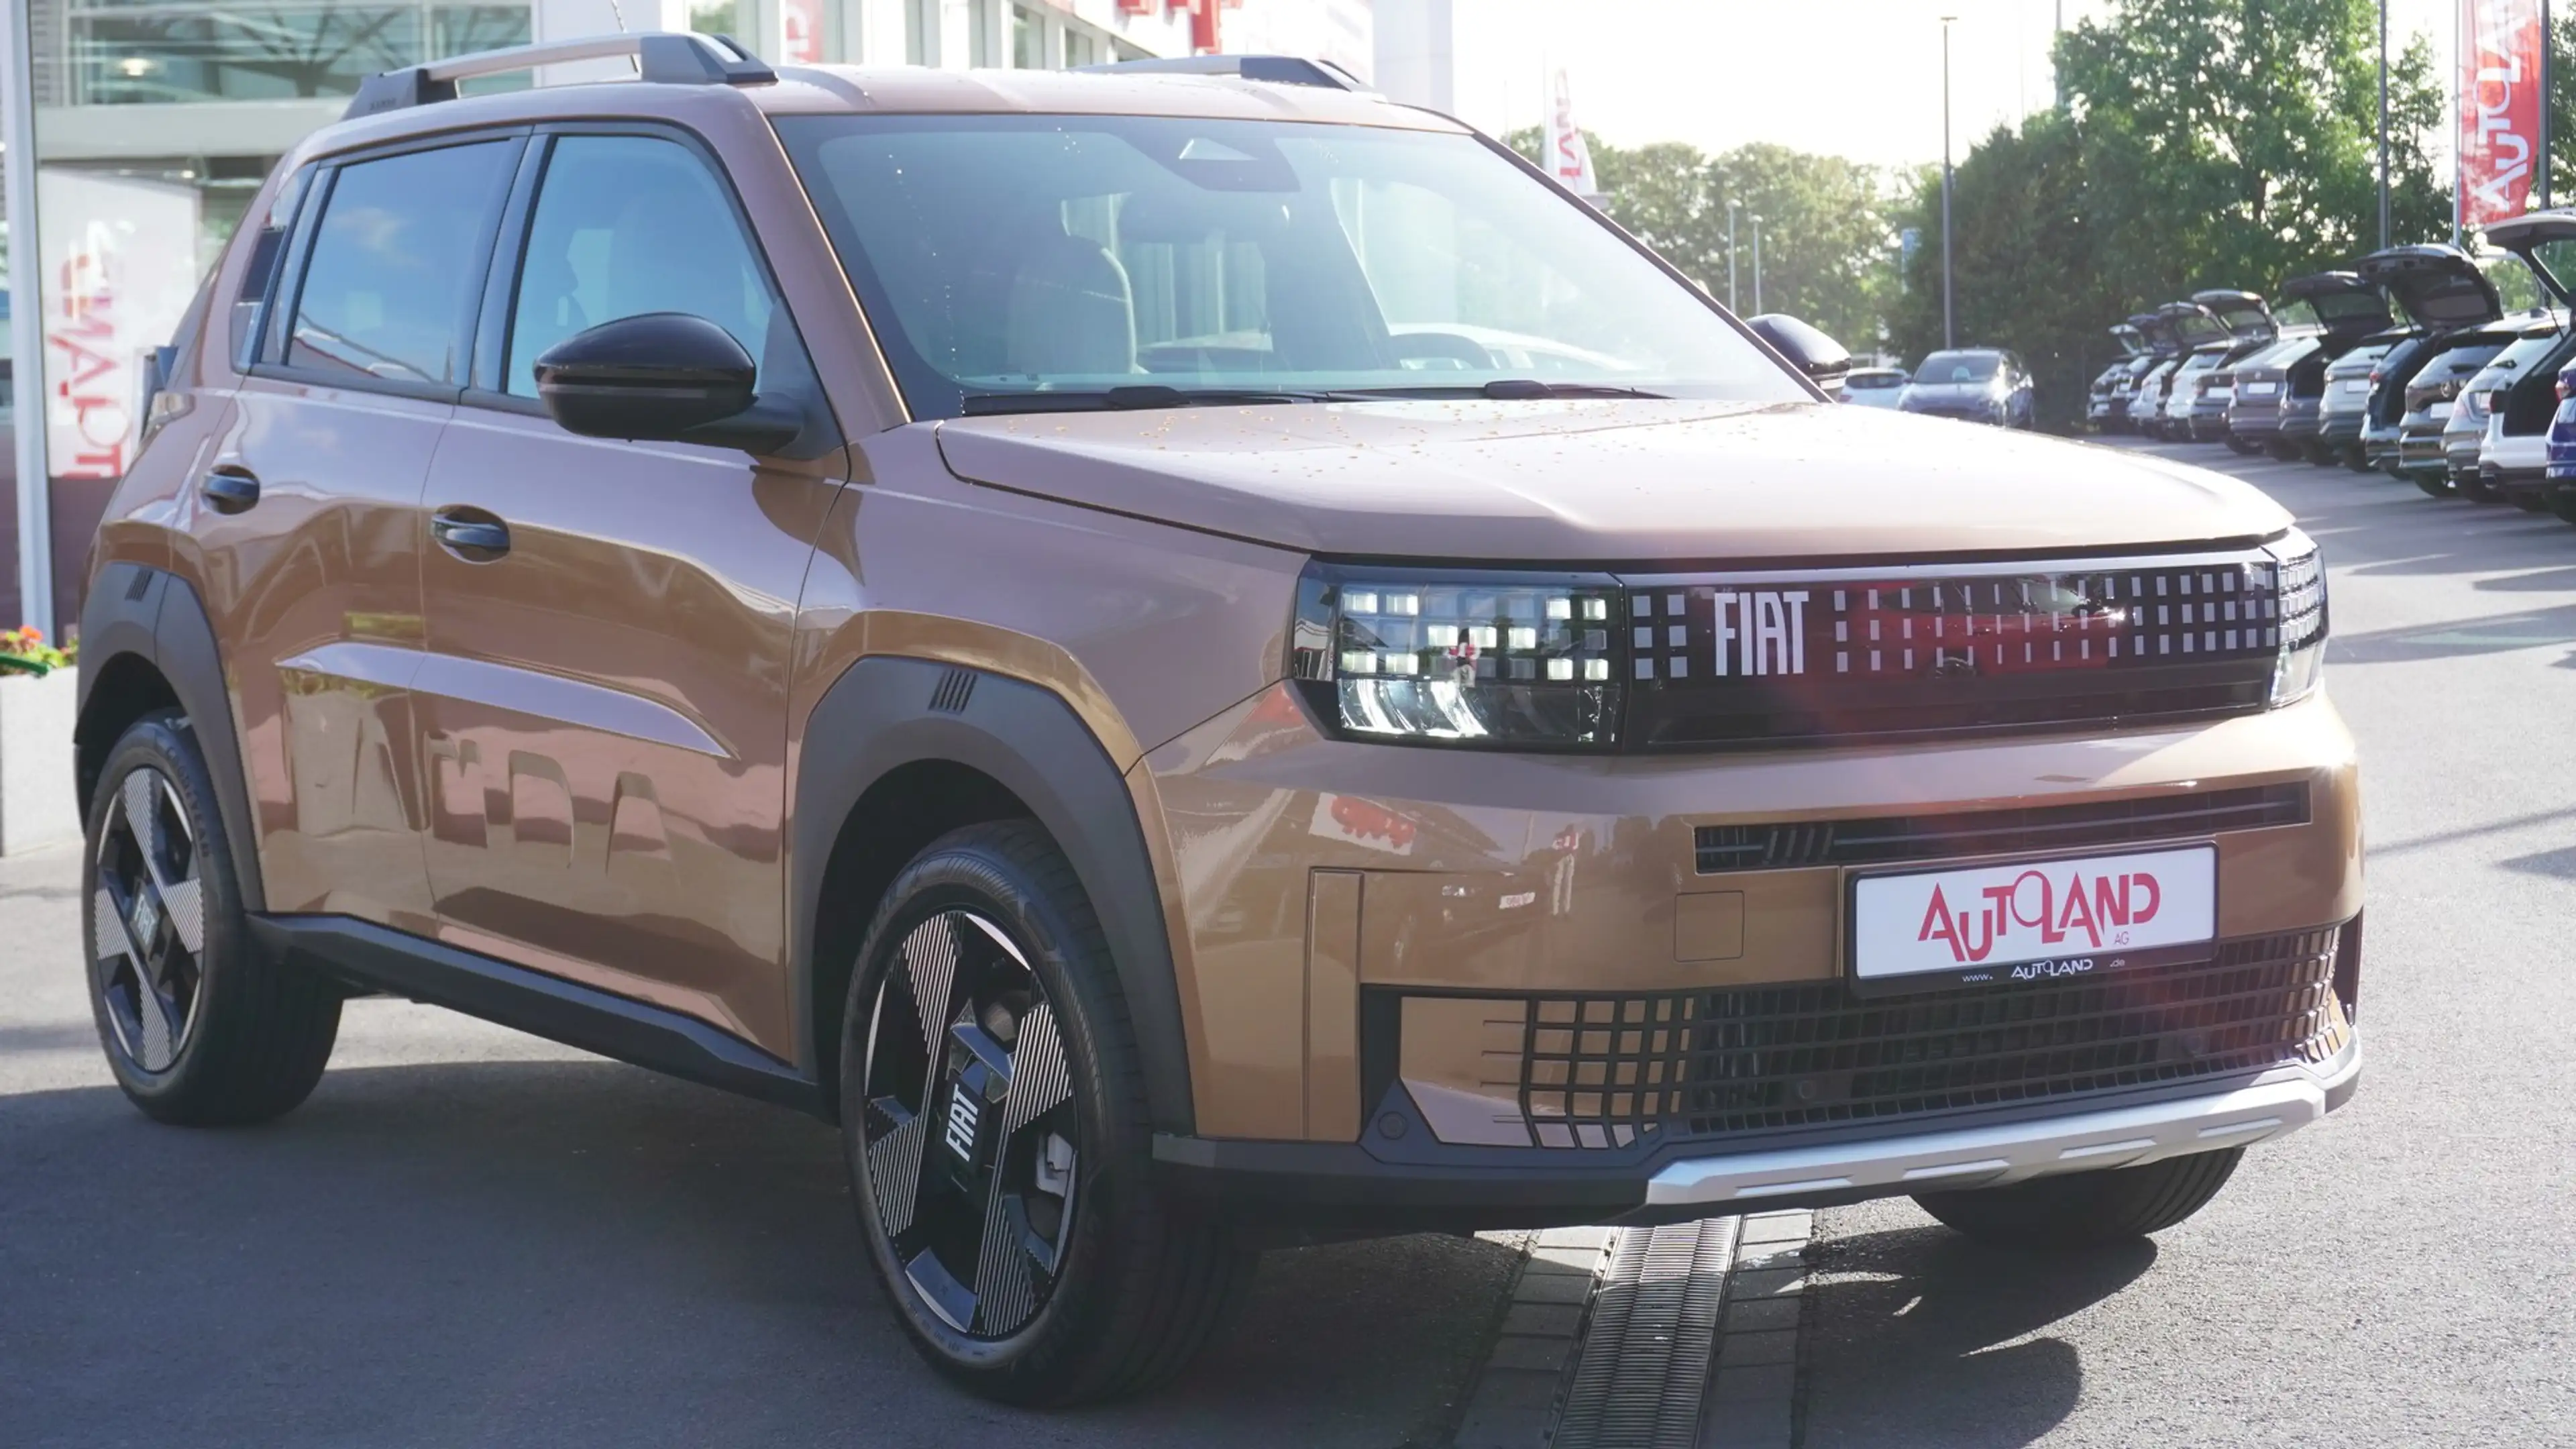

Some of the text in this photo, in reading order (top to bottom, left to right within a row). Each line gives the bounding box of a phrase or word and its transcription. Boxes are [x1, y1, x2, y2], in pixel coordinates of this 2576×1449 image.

[2473, 0, 2528, 212] AUTOLA
[1715, 591, 1809, 676] FIAT
[134, 892, 155, 945] FIAT
[1918, 870, 2161, 962] AUTOLAND
[2114, 931, 2129, 946] AG
[2010, 959, 2094, 980] AUTOLAND
[946, 1083, 979, 1162] FIAT
